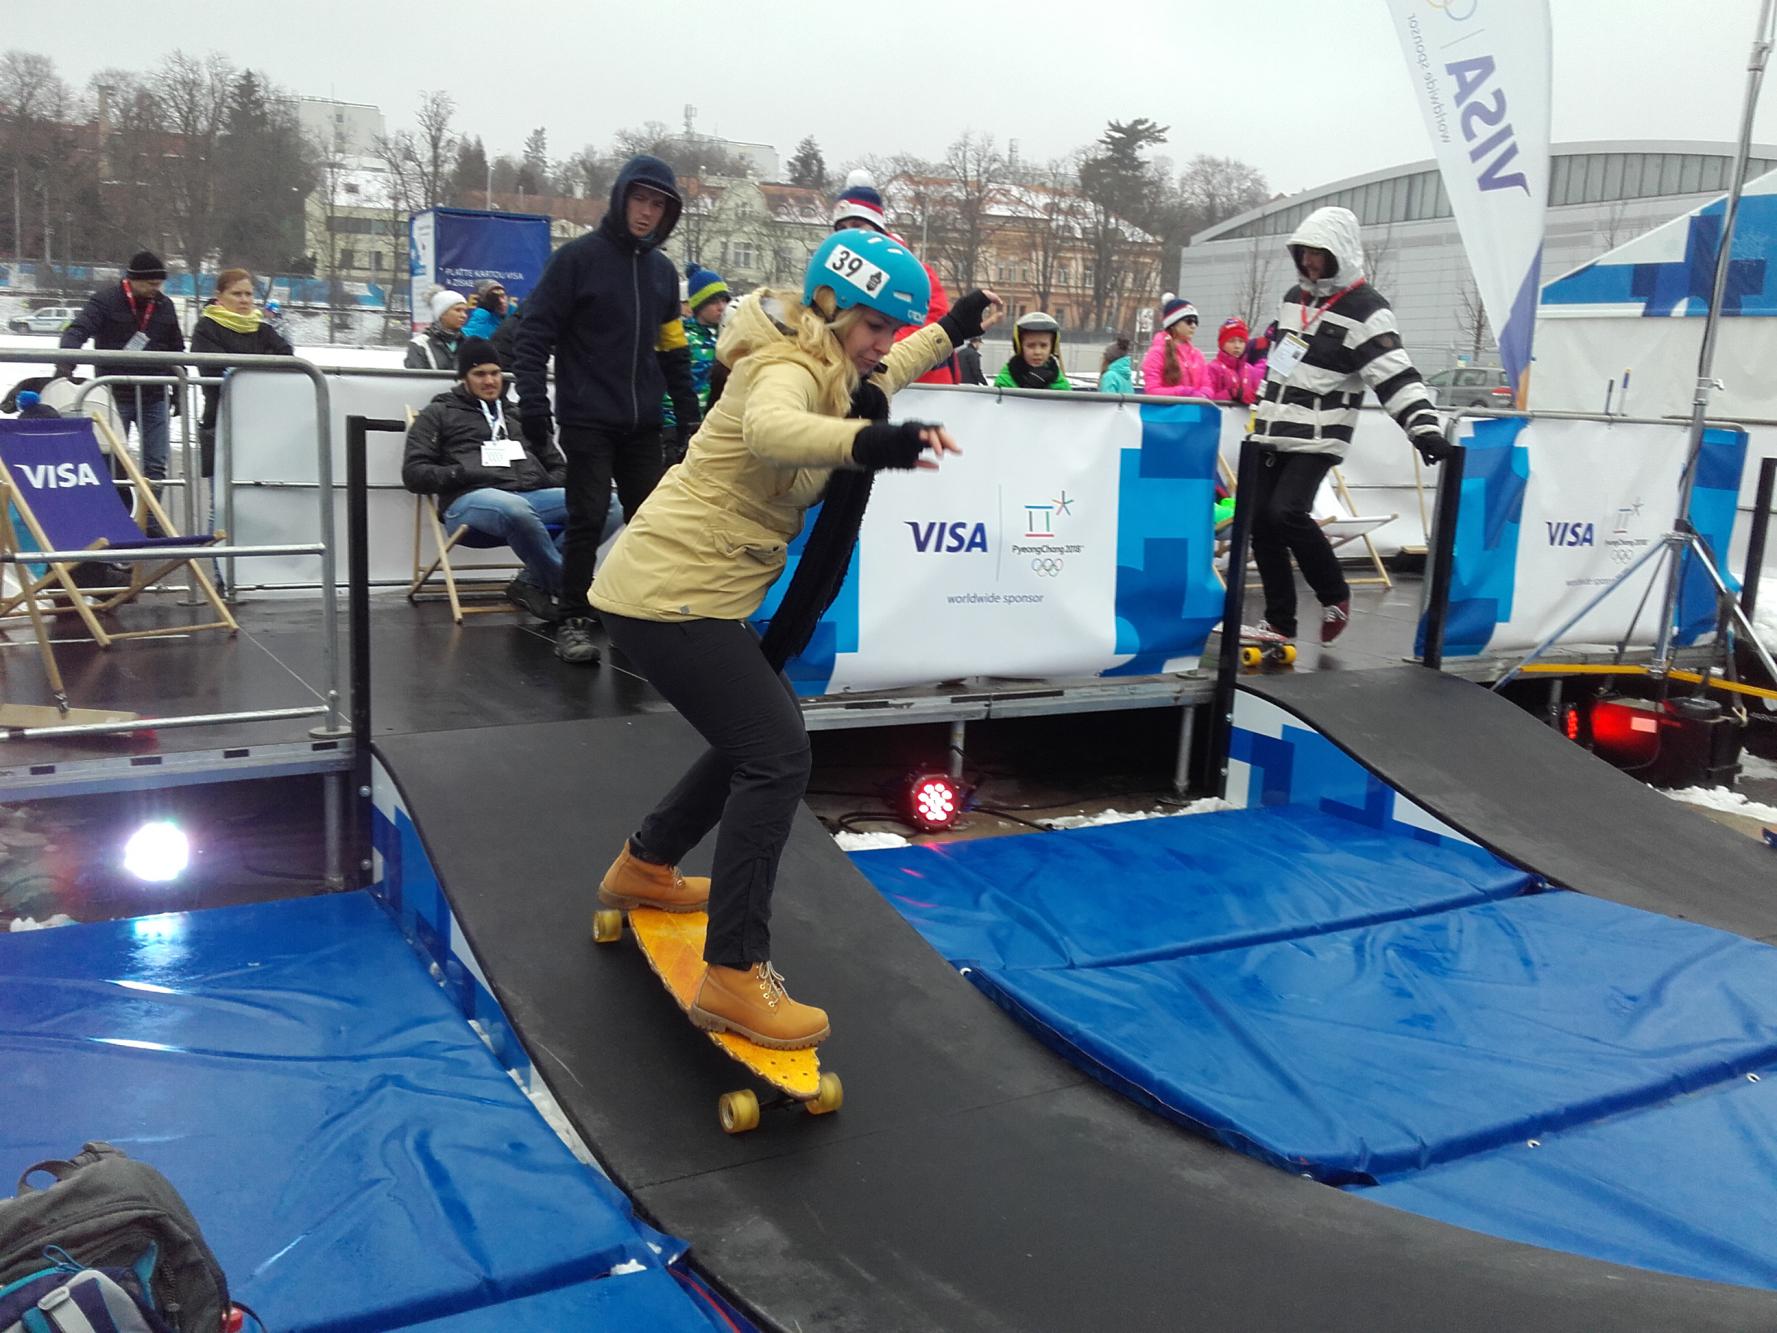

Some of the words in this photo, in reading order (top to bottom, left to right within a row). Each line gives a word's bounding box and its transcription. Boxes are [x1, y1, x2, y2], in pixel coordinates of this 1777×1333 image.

[832, 250, 863, 277] 39
[13, 463, 100, 489] VISA
[904, 521, 988, 553] VISA
[1545, 521, 1594, 546] VISA
[1012, 545, 1064, 555] PyeongChang
[947, 593, 1000, 604] worldwide
[1003, 595, 1044, 605] sponsor
